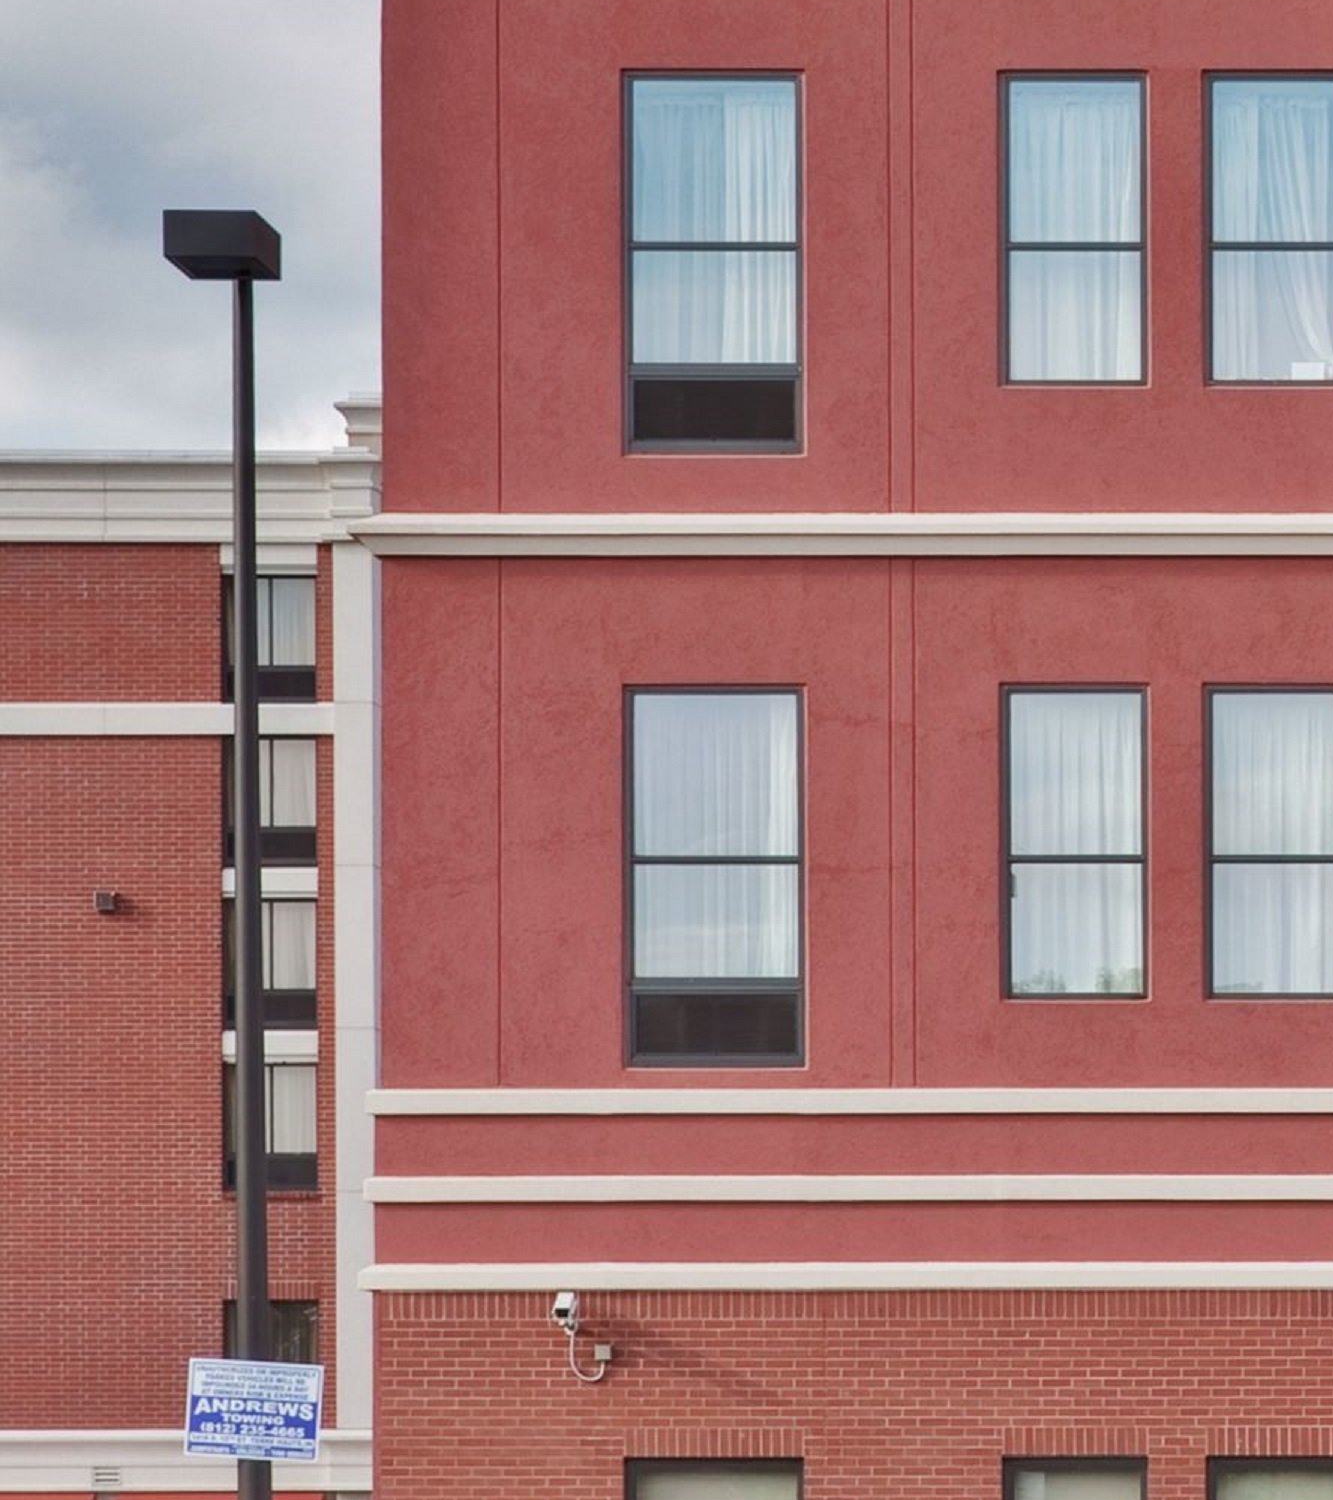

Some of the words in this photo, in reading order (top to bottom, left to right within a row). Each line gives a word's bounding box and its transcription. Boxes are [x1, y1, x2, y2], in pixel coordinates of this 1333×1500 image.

[194, 1398, 314, 1421] ANDREWS
[222, 1413, 285, 1426] TOWING
[200, 1421, 237, 1434] (812)
